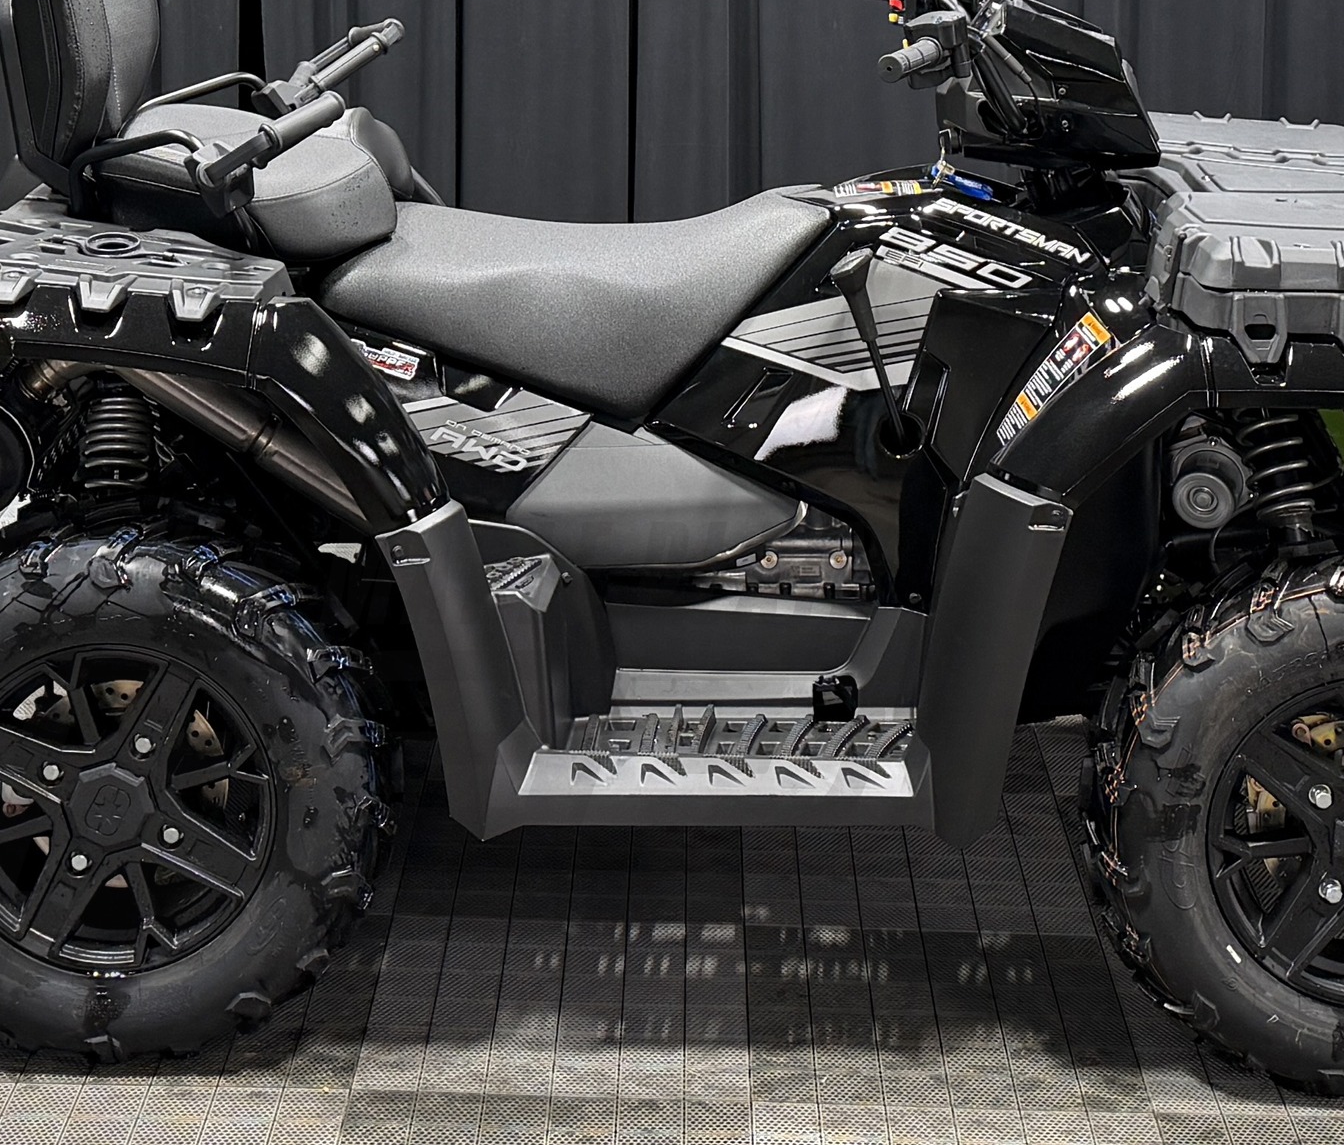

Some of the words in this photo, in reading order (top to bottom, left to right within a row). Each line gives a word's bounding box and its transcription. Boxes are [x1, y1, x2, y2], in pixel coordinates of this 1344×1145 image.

[929, 197, 1091, 263] SPORTSMAN
[879, 226, 1033, 289] 850
[430, 426, 528, 472] AWD
[471, 429, 531, 455] DEMAND
